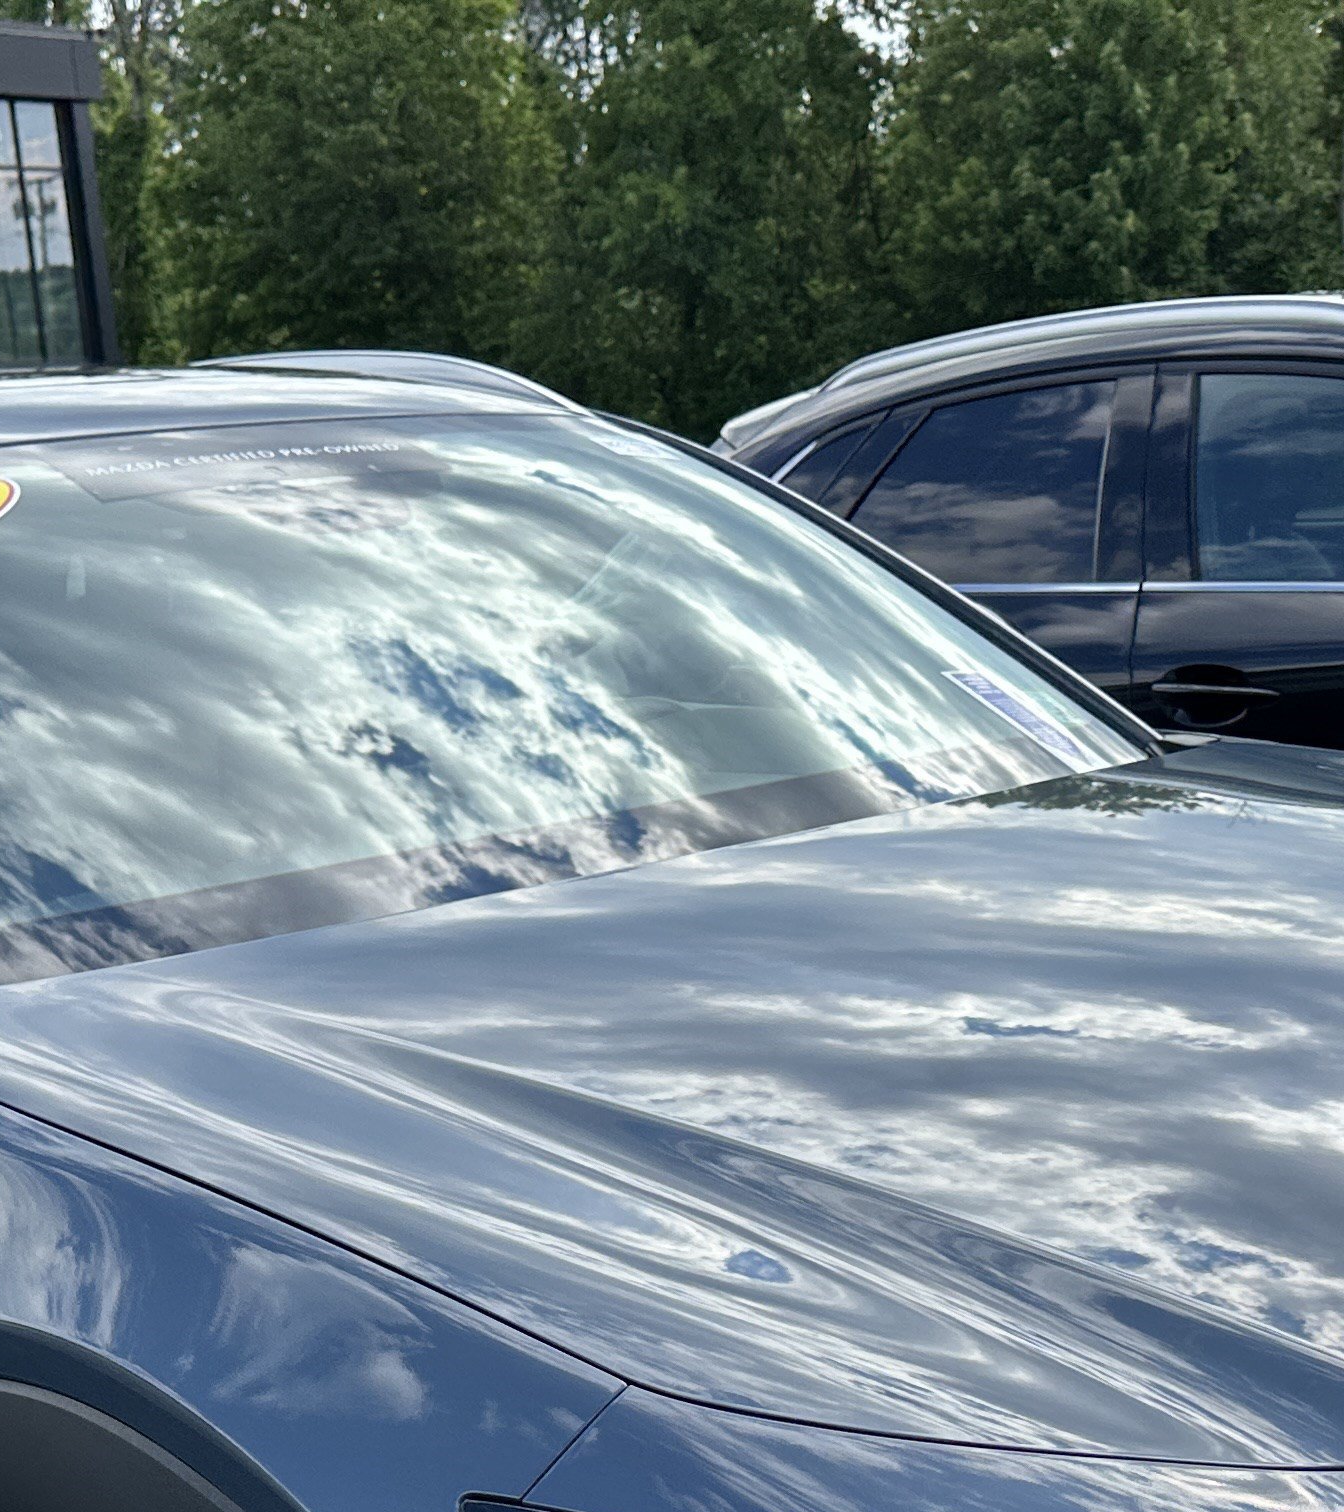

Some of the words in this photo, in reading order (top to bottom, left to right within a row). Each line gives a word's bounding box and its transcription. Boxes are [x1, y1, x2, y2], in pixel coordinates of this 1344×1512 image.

[85, 459, 171, 477] MAZDA
[173, 449, 276, 467] CERTIFIED
[278, 442, 400, 458] PRE-OWNED
